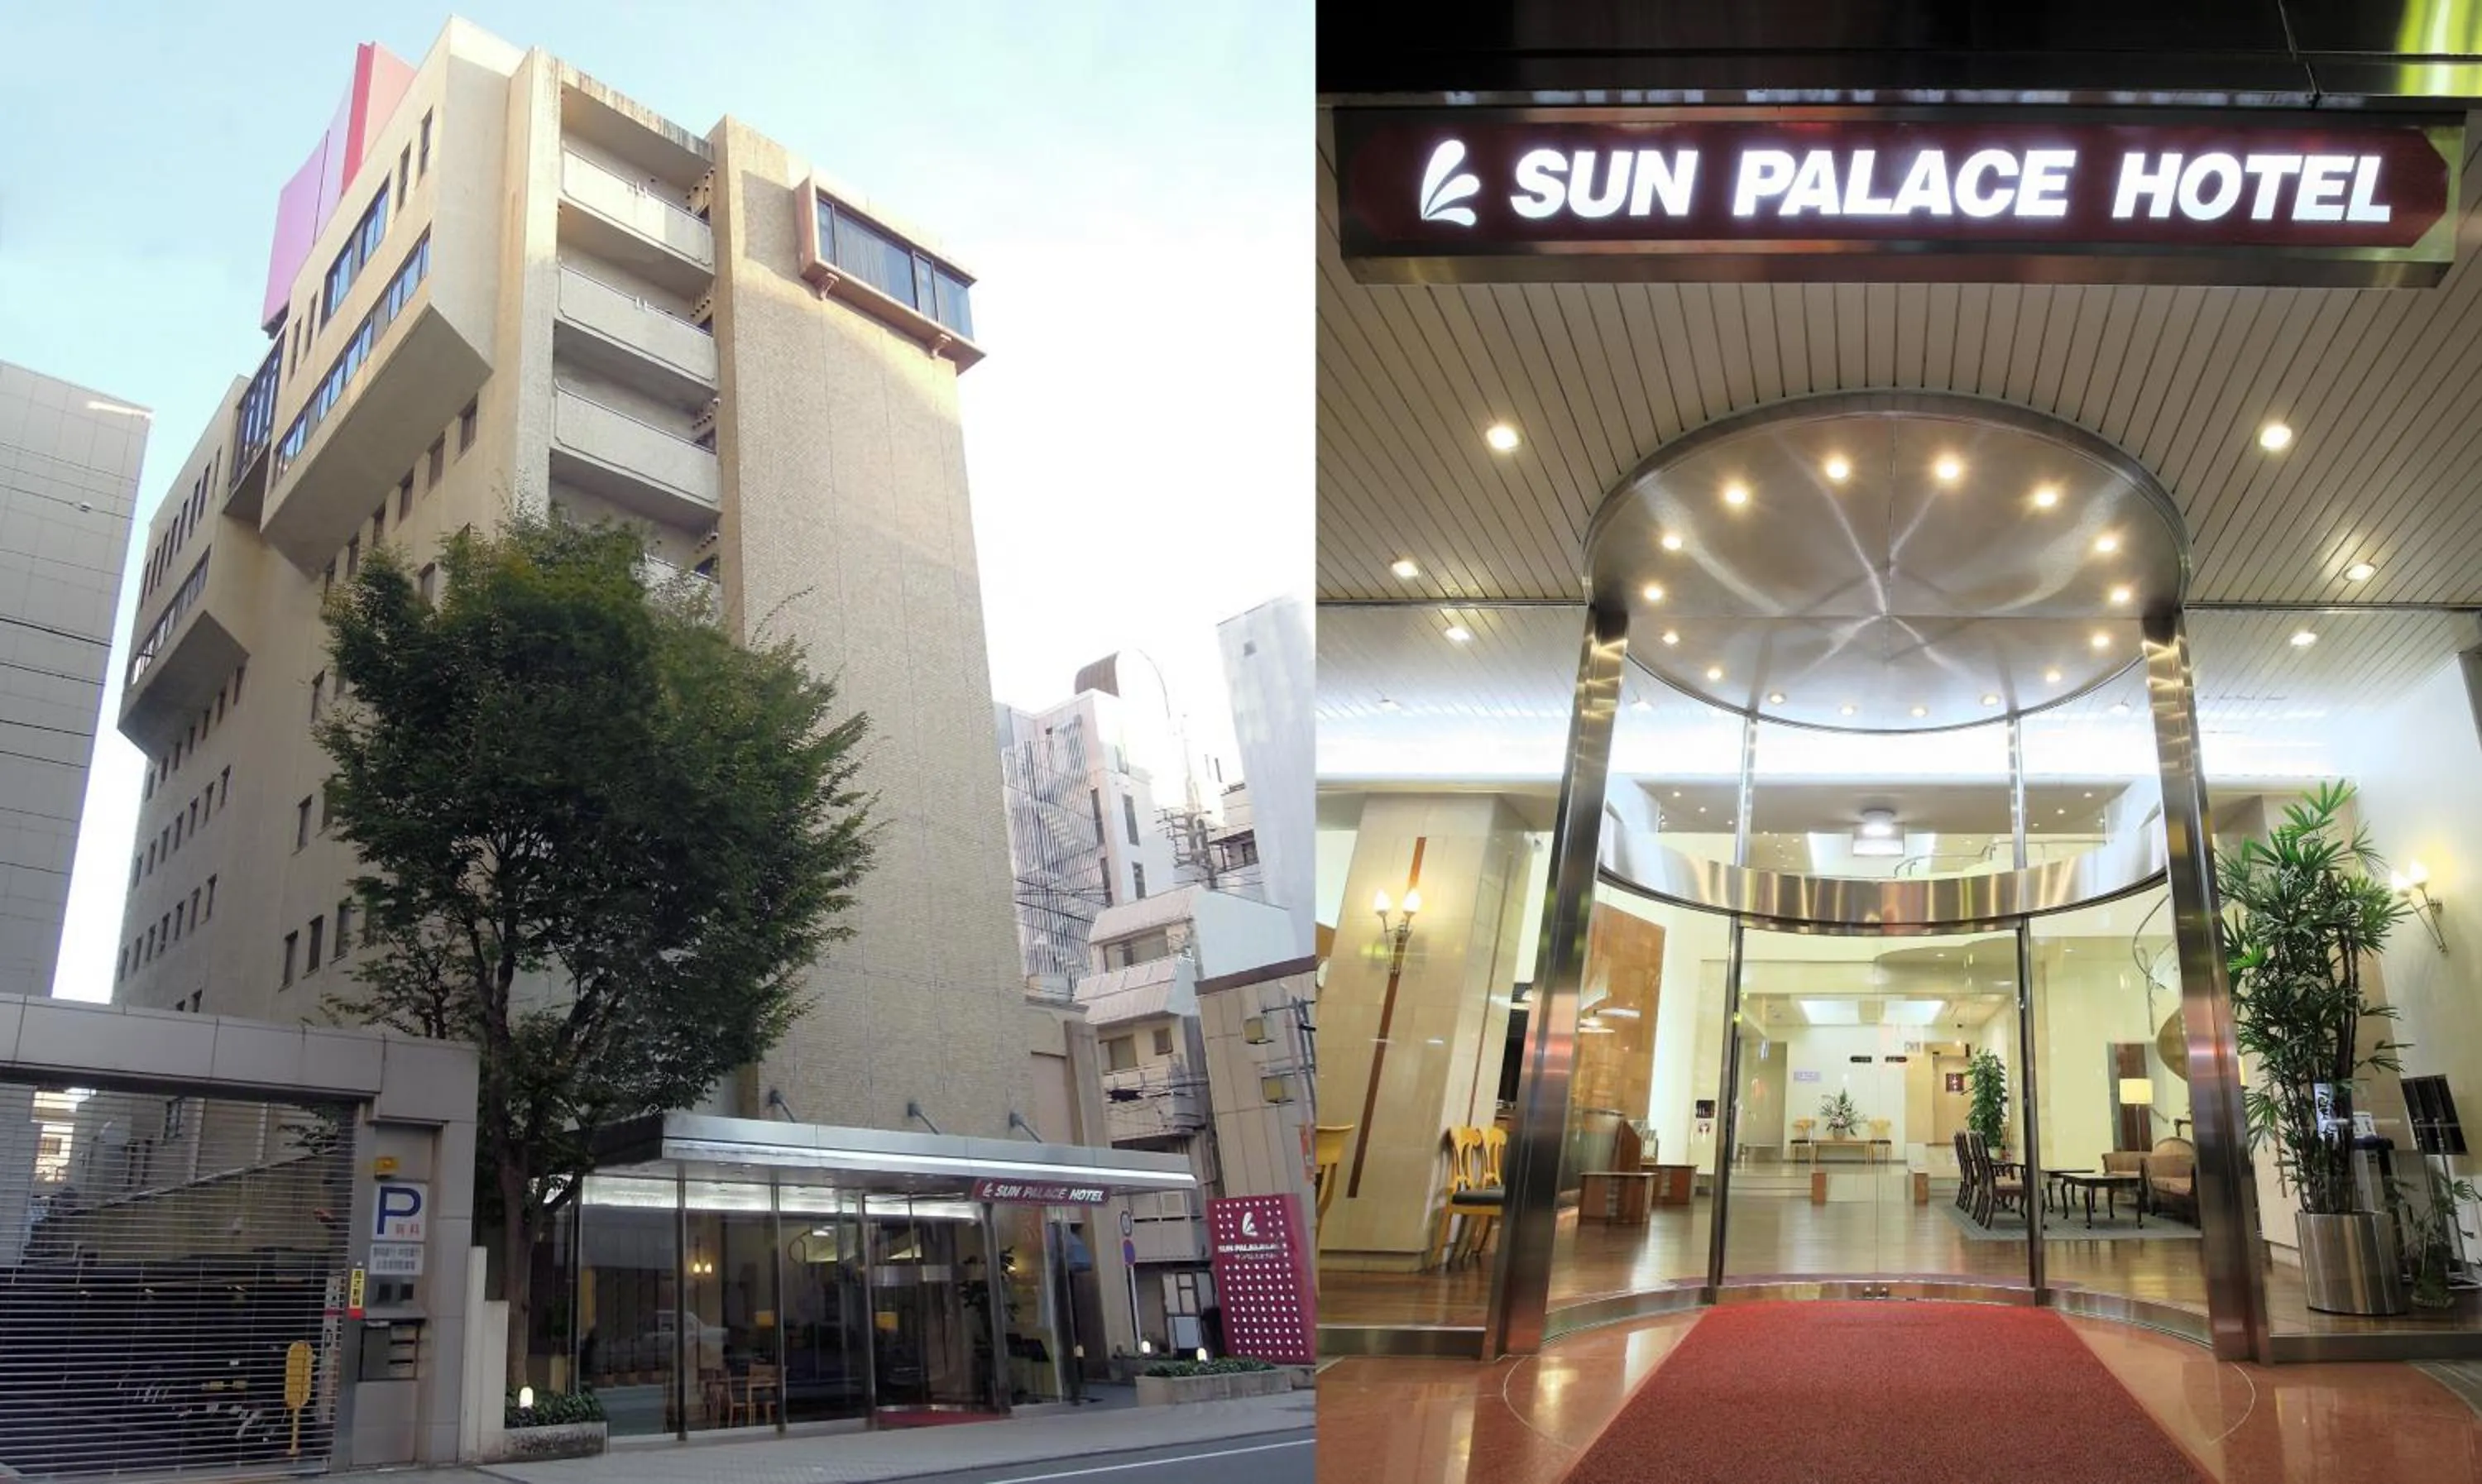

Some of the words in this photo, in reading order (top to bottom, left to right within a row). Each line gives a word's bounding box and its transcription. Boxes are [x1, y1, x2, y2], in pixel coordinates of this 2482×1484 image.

[1509, 148, 1699, 218] SUN
[1732, 149, 2077, 218] PALACE
[2111, 151, 2392, 223] HOTEL
[376, 1185, 422, 1235] P
[994, 1184, 1022, 1198] SUN
[1023, 1185, 1068, 1199] PALACE
[1068, 1188, 1104, 1202] HOTEL
